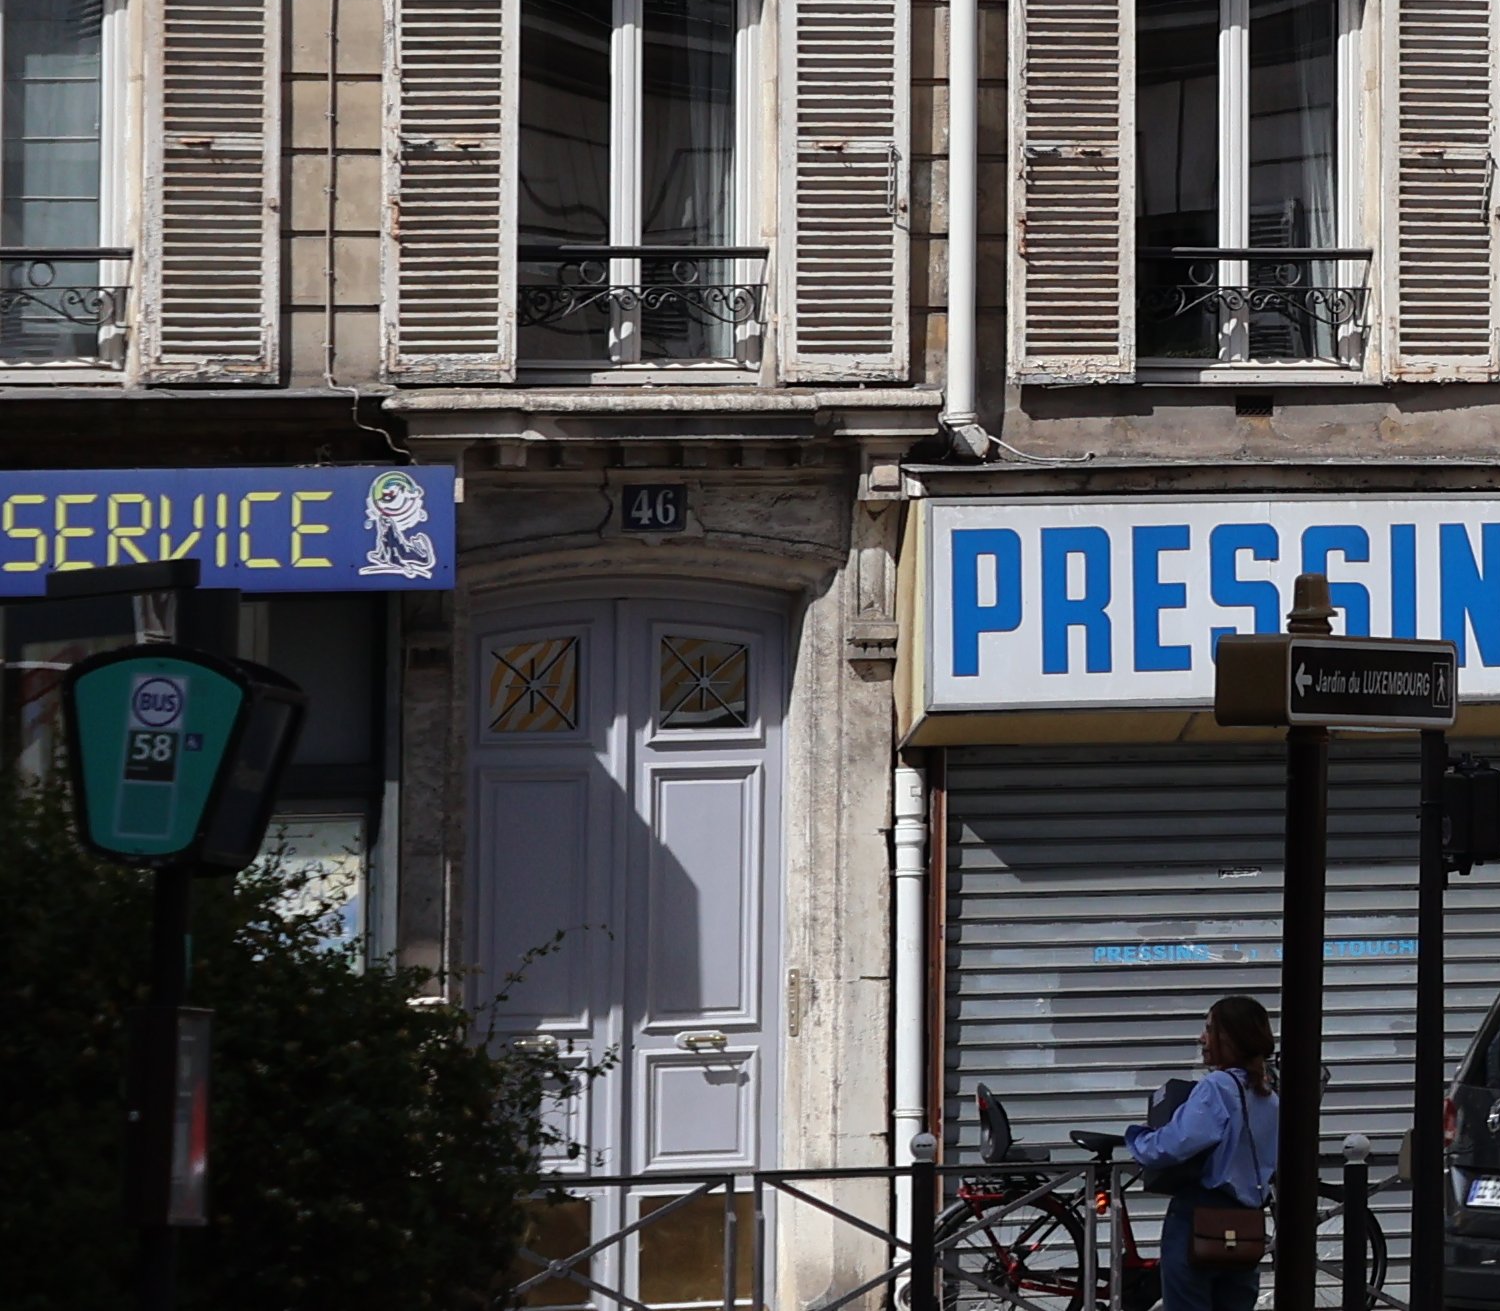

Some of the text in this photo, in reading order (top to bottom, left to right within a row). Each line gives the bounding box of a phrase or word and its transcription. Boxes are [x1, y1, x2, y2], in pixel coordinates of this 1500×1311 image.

[631, 489, 676, 525] 46
[2, 491, 333, 572] SERVICE
[1315, 668, 1431, 697] Jardin du LUXEMBOURG
[140, 692, 176, 713] BUS
[131, 734, 172, 761] 58
[1325, 939, 1419, 959] ETOUCH
